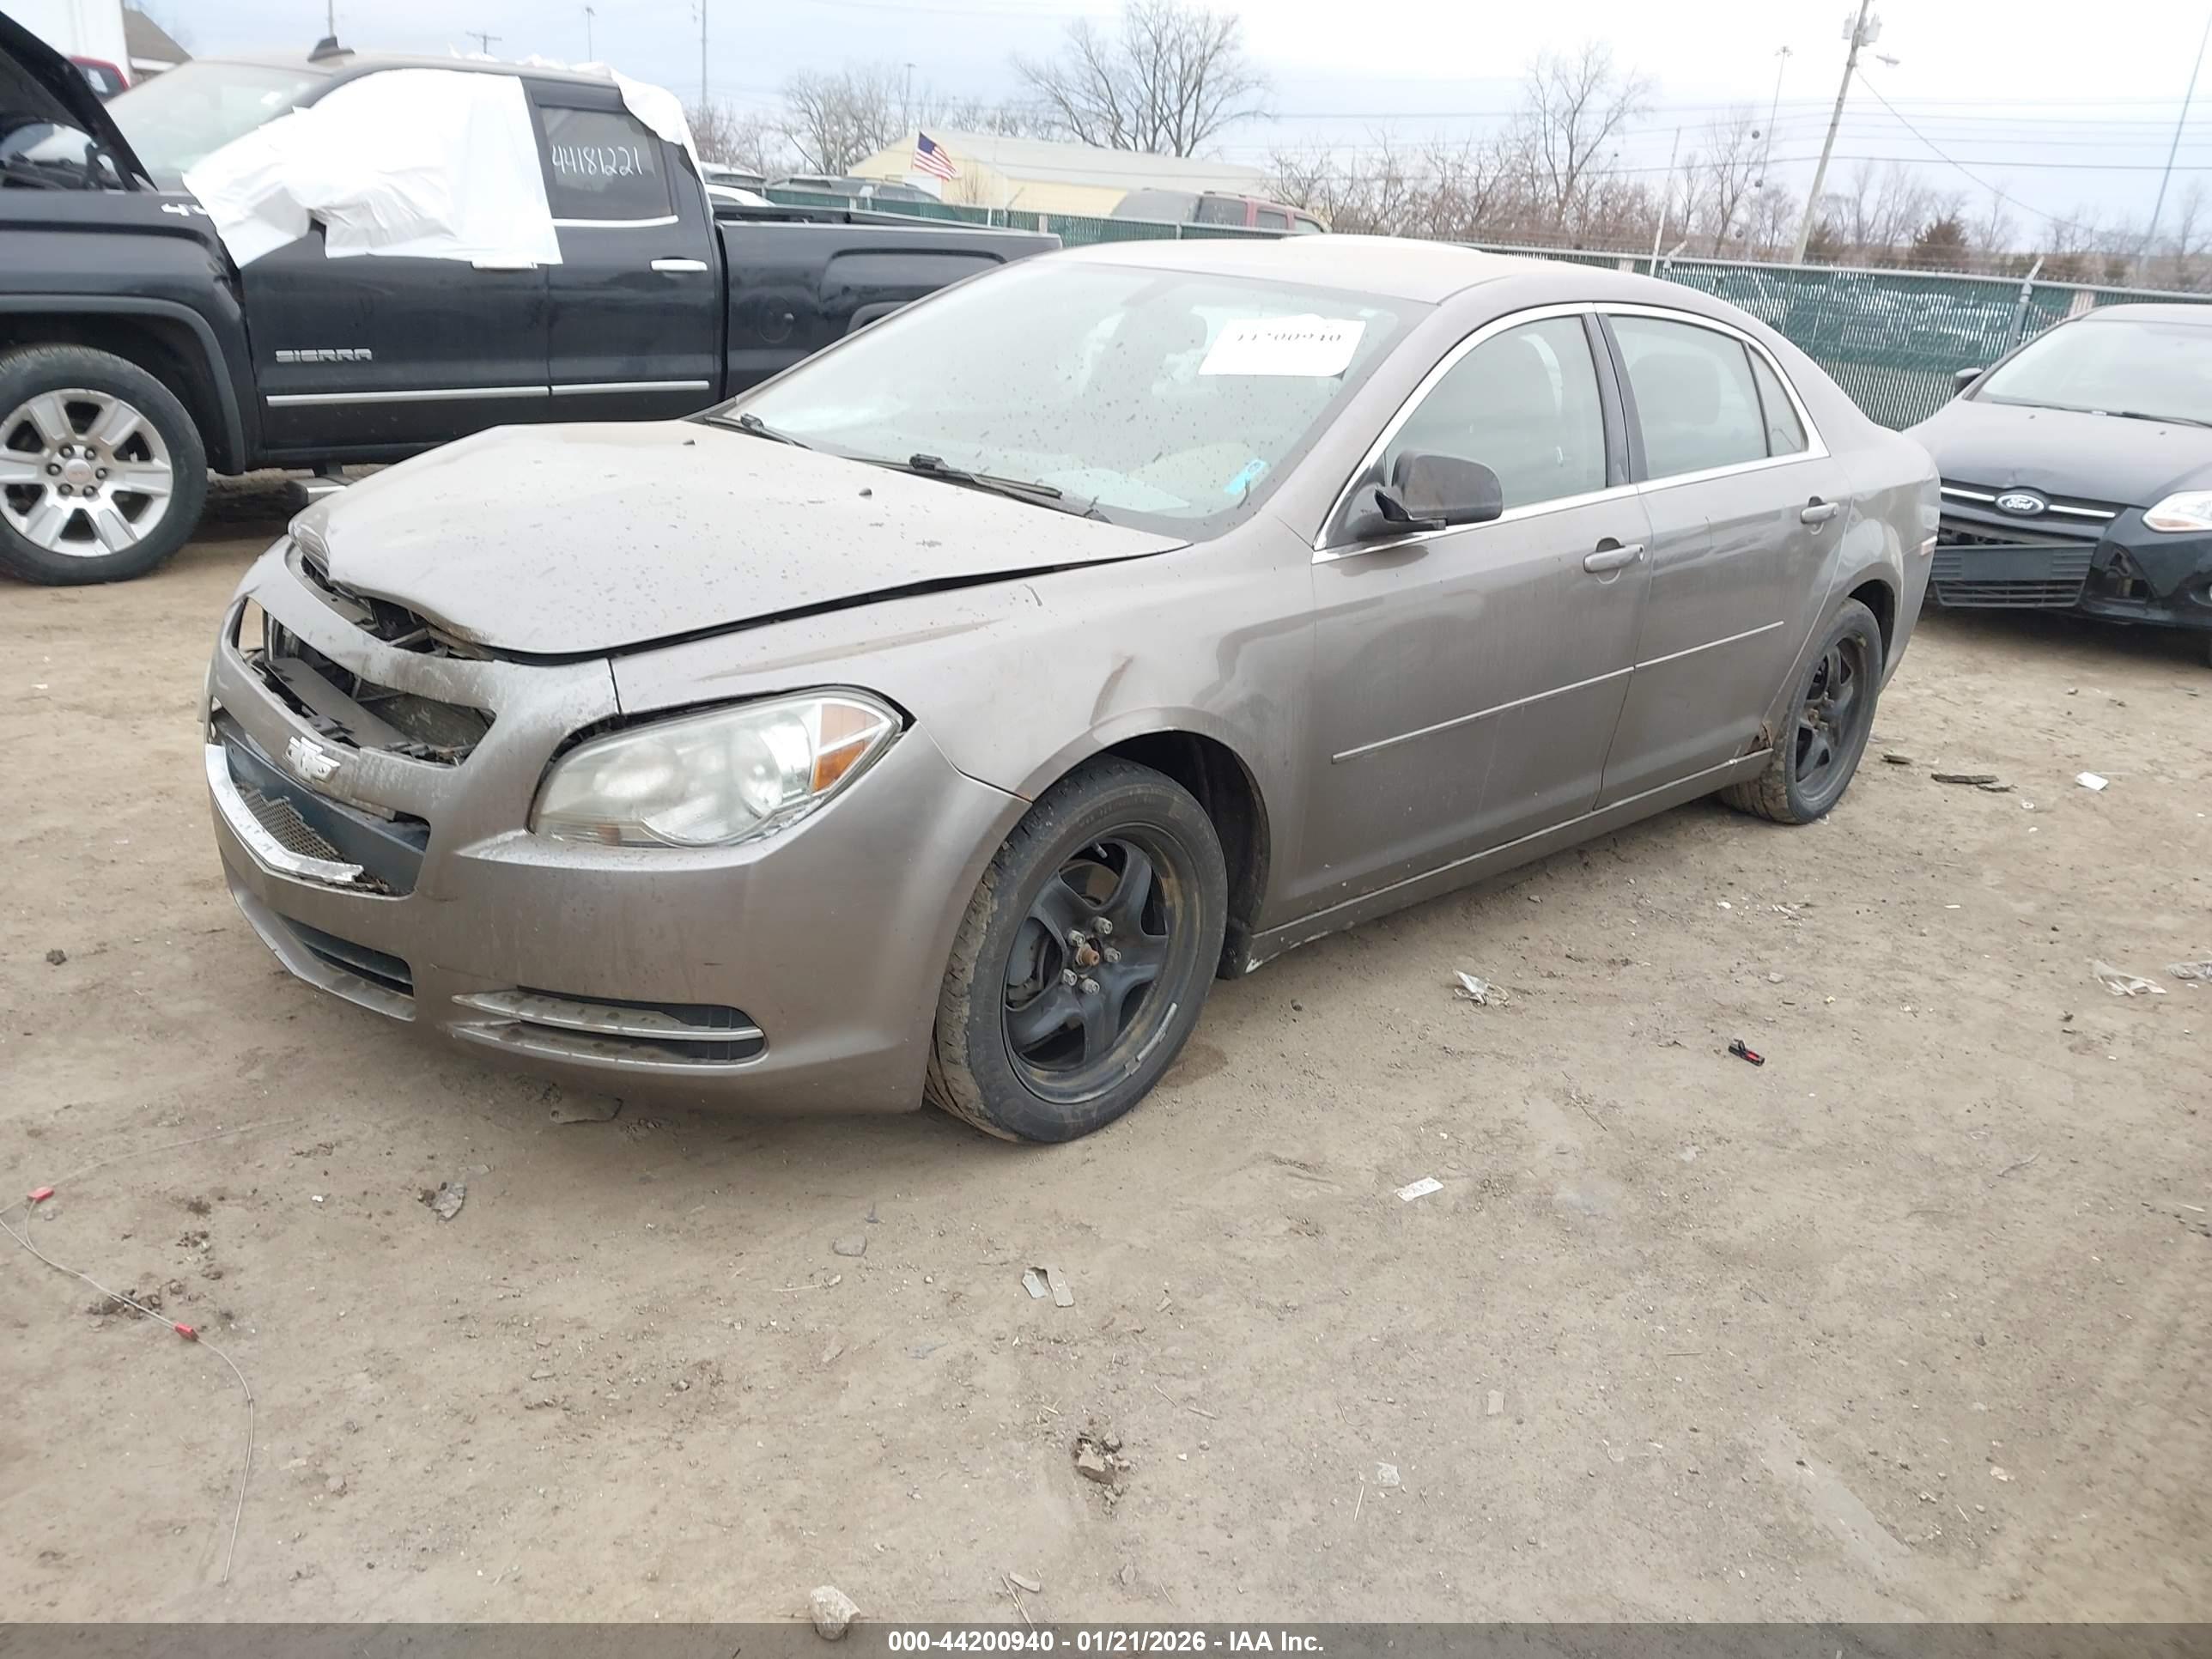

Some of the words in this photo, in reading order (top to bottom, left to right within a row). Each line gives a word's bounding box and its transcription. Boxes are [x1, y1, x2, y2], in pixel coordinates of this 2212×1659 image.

[551, 143, 643, 176] 44181221
[275, 348, 373, 363] SIERRA
[2005, 497, 2034, 510] Ford
